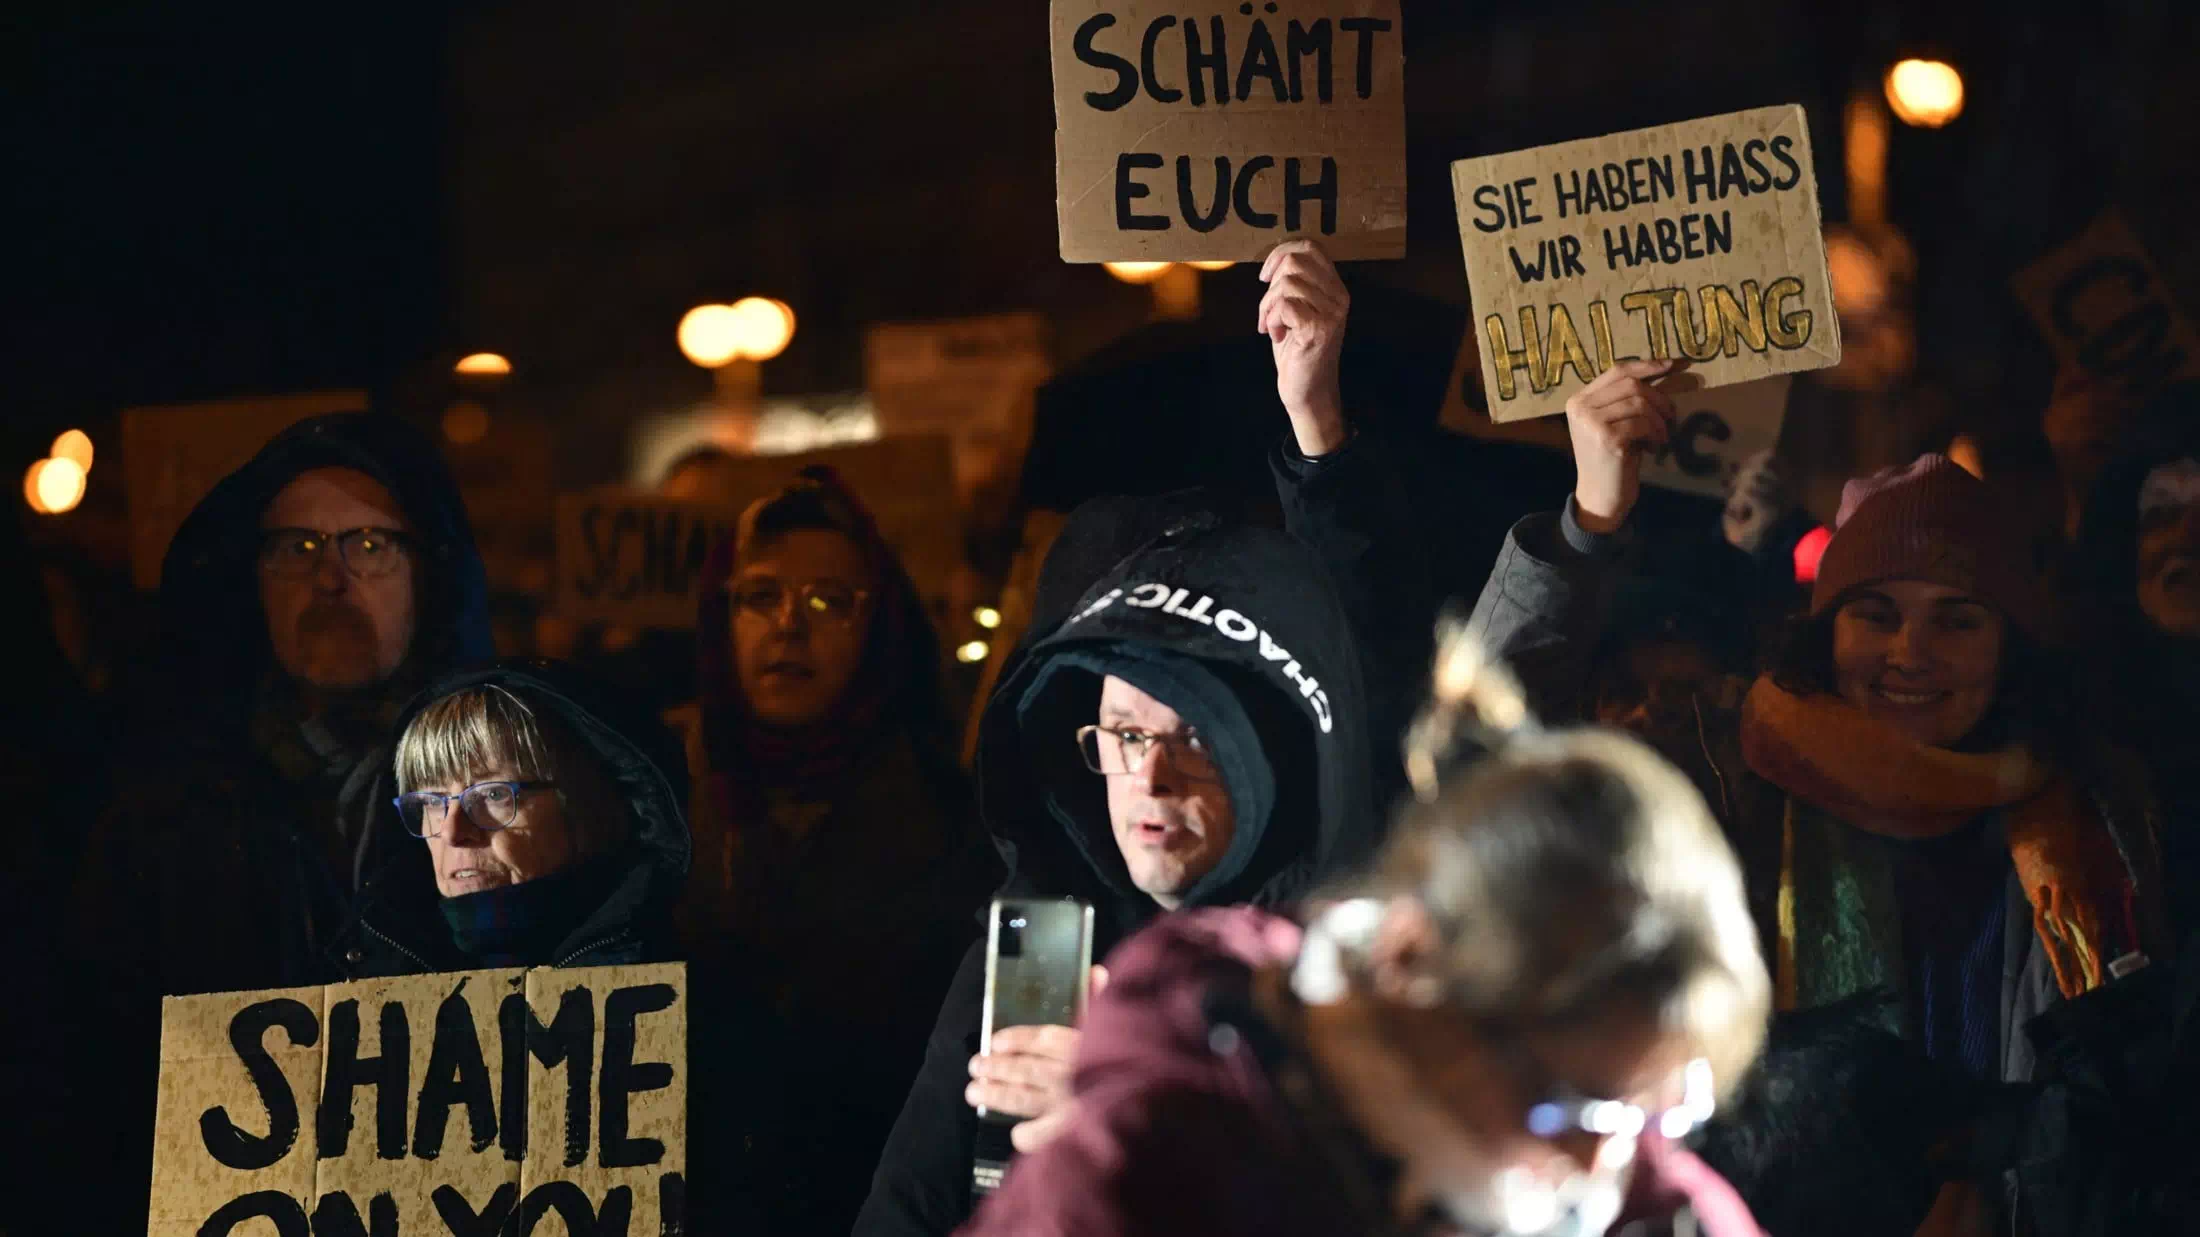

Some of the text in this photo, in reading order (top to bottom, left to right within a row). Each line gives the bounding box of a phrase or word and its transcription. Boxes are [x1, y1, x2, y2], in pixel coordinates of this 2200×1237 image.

[1073, 1, 1392, 112] SCHÄMT
[1115, 153, 1338, 236] EUCH
[1473, 135, 1801, 232] SIE HABEN HASS
[1508, 210, 1733, 283] WIR HABEN
[1485, 277, 1813, 401] HALTUNG
[1125, 582, 1333, 734] CHAOTIC
[200, 982, 678, 1169] SHAME
